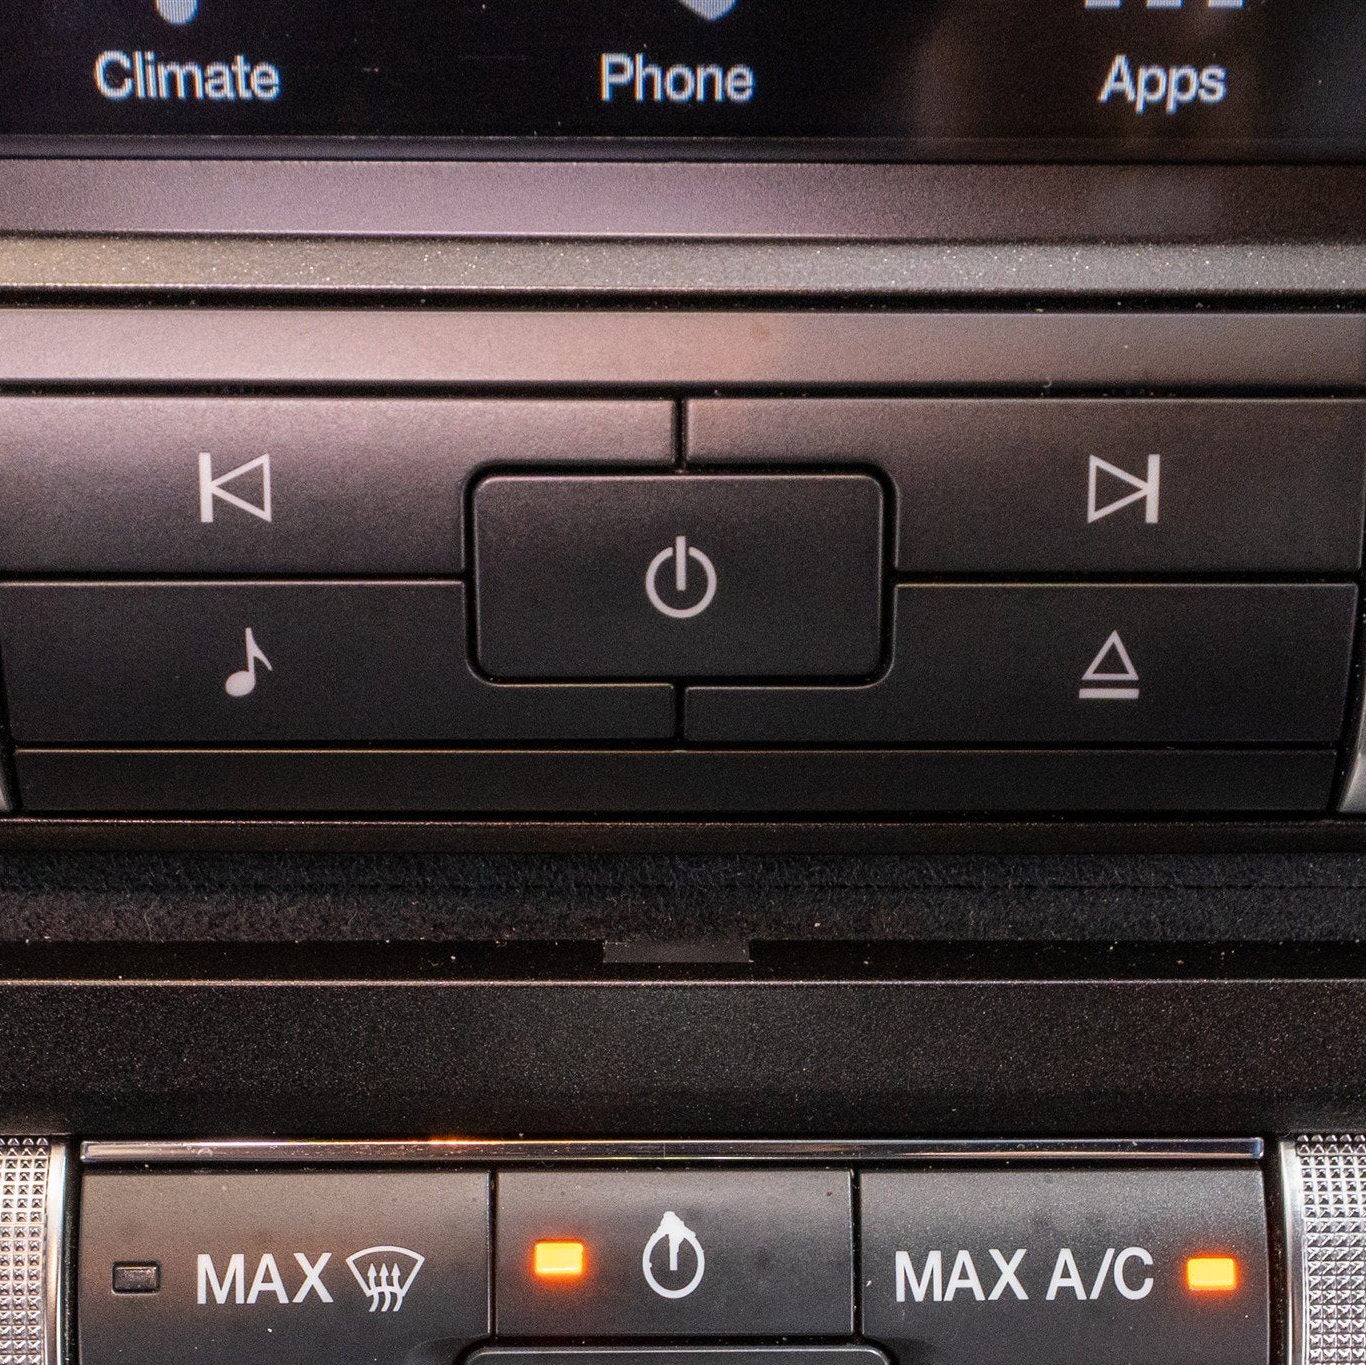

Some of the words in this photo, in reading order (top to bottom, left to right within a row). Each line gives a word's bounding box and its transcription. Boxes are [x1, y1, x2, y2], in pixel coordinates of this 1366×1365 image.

[93, 50, 281, 101] Climate
[600, 53, 755, 103] Phone
[1098, 54, 1228, 113] Apps
[196, 1252, 333, 1305] MAX
[895, 1248, 1029, 1303] MAX
[1045, 1246, 1155, 1301] A/C
